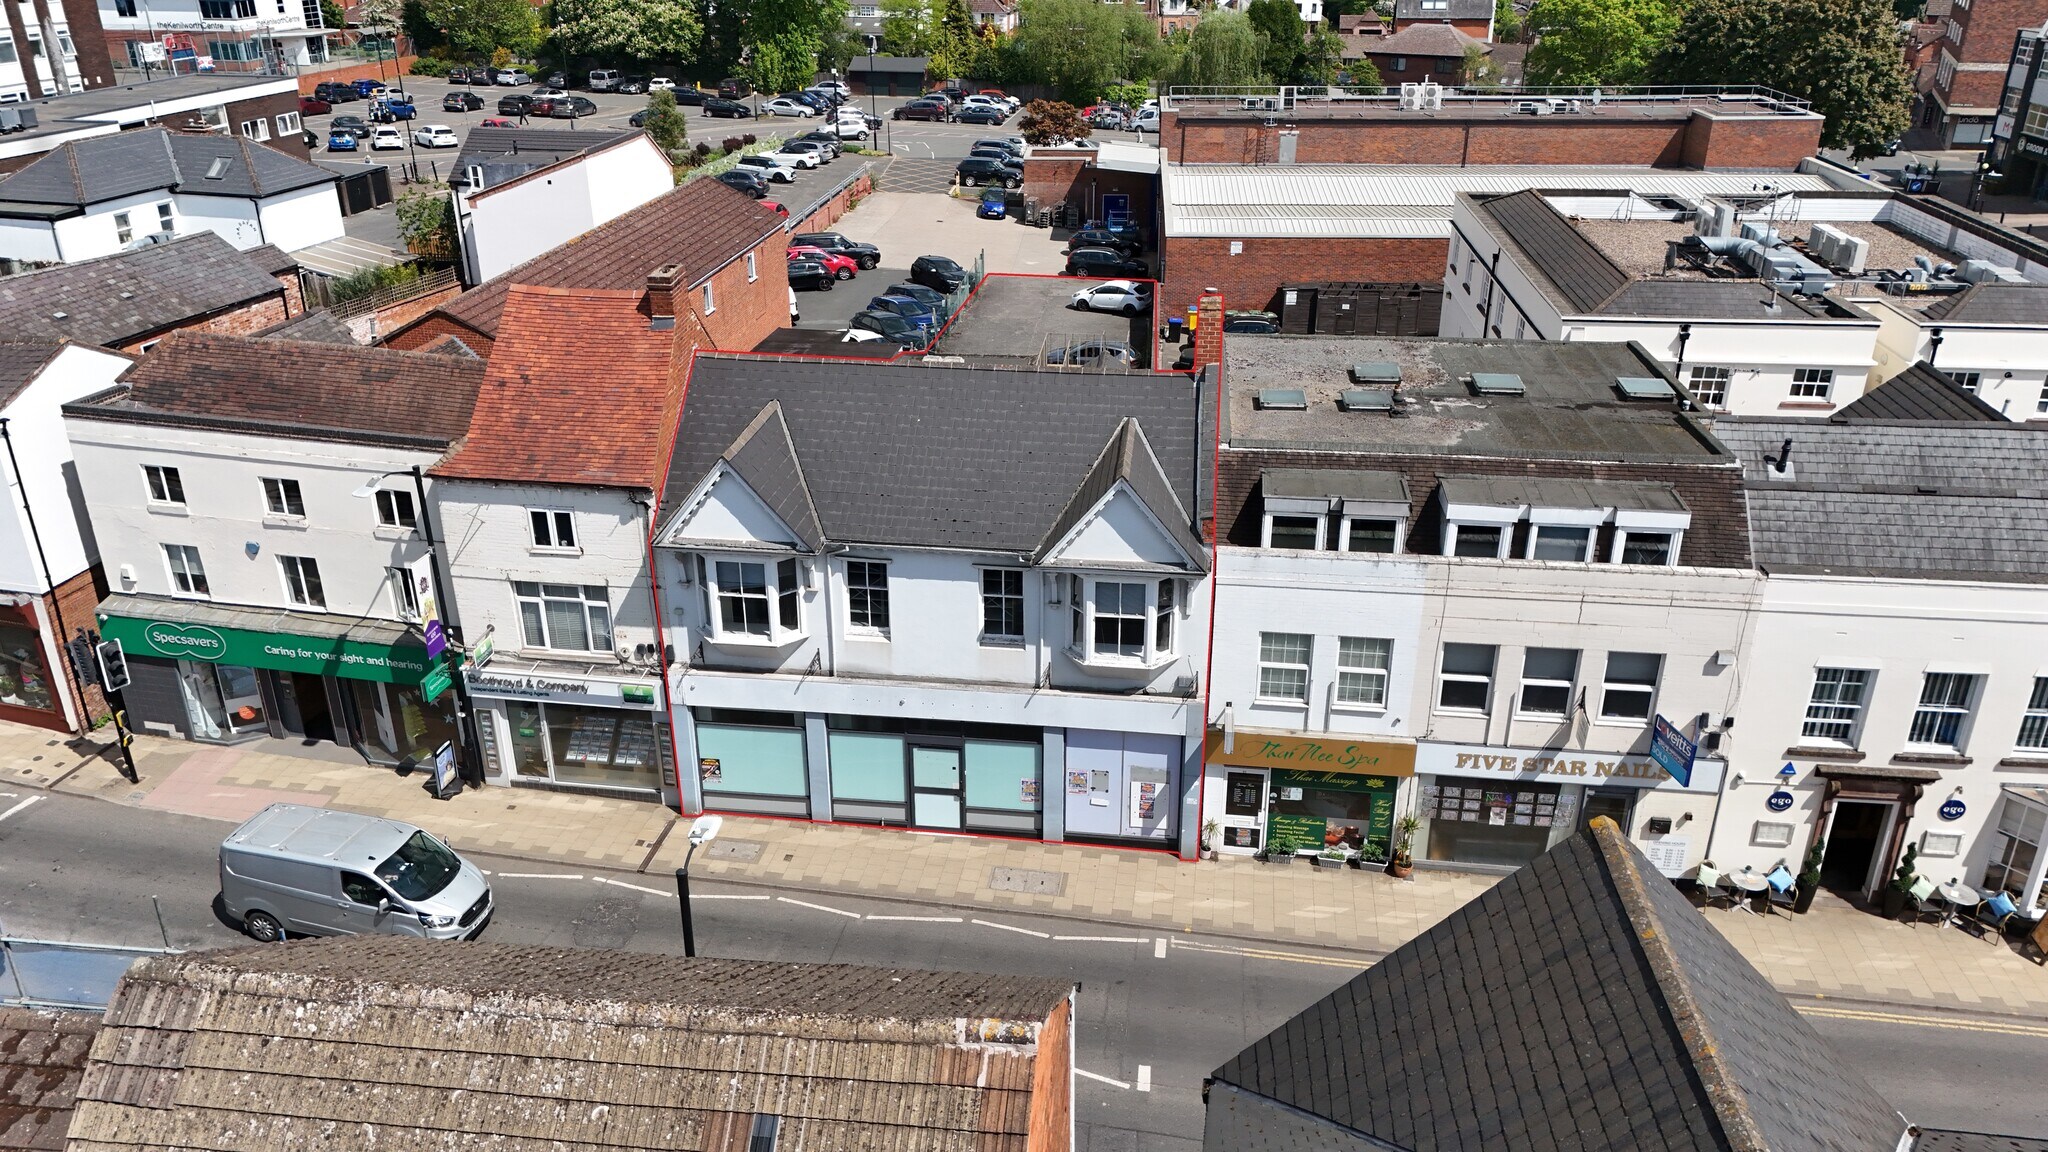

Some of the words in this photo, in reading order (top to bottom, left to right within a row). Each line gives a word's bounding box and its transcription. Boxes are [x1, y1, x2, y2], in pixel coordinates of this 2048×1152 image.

[157, 21, 224, 30] theKenilworthCentre
[2026, 142, 2044, 154] GROOM
[153, 631, 219, 648] Specsavers
[264, 645, 297, 658] Caring
[297, 648, 312, 658] for
[314, 651, 337, 661] your
[339, 653, 365, 664] sight
[366, 656, 385, 666] and
[385, 657, 424, 672] hearing
[468, 673, 523, 689] Boothroyd
[537, 679, 589, 694] Company
[1241, 741, 1294, 759] Thai
[1338, 745, 1379, 769] Spa
[1652, 744, 1668, 764] SOLD
[1455, 752, 1517, 772] FIVE
[1522, 757, 1588, 777] STAR
[1594, 761, 1672, 782] NAILS
[1285, 770, 1314, 781] Thai
[1315, 772, 1358, 788] Massage
[1771, 797, 1791, 806] ego
[1943, 806, 1964, 815] ego
